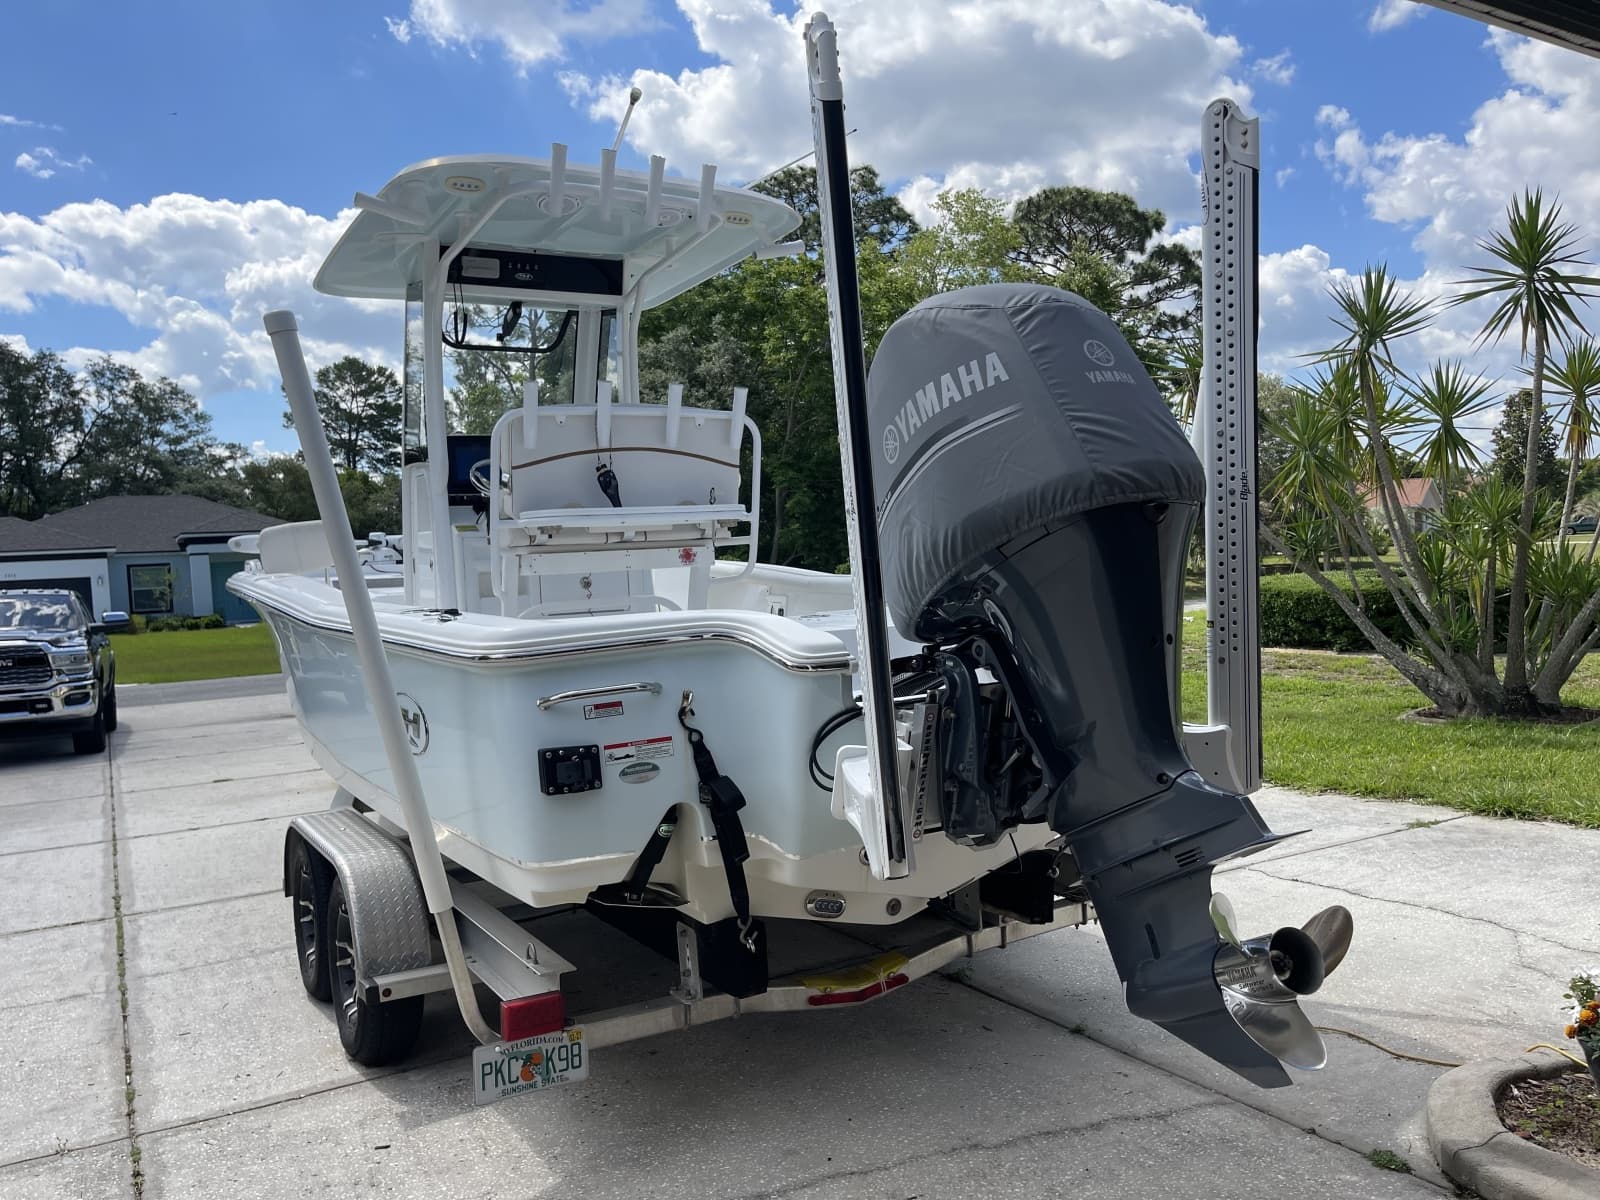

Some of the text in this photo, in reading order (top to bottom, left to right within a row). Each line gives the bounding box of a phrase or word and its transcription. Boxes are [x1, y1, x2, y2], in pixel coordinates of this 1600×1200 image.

[1085, 370, 1137, 385] YAMAHA
[894, 351, 1010, 443] YAMAHA
[545, 1042, 582, 1075] K98
[501, 1074, 566, 1097] SUNSHINE STATE
